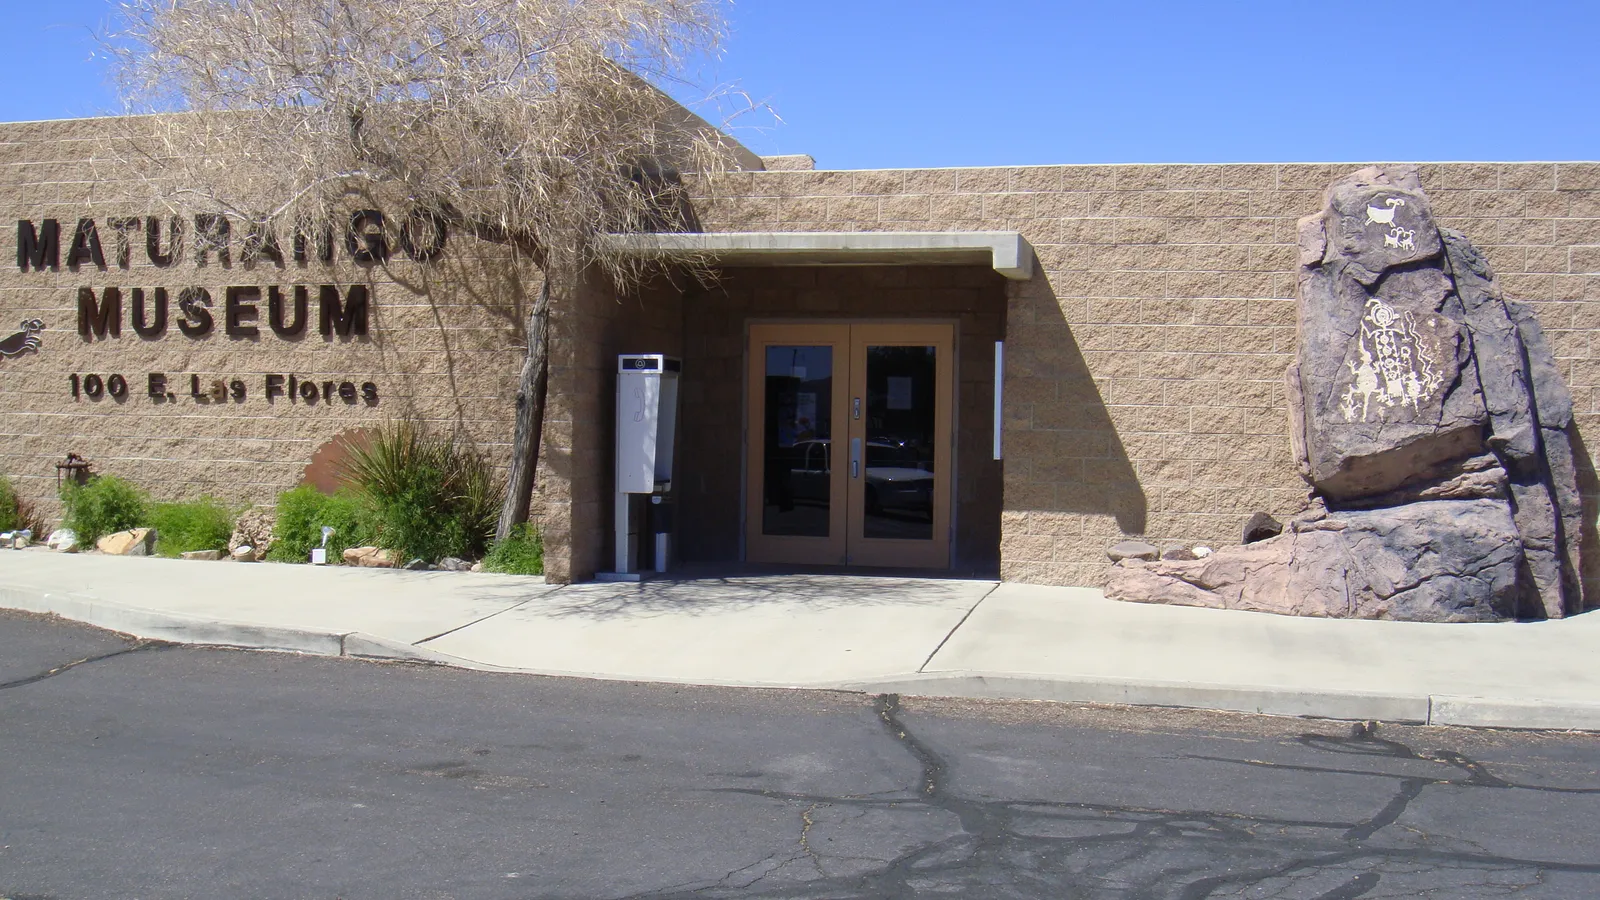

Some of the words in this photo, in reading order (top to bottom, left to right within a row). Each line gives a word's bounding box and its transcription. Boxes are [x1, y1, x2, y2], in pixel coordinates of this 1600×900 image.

[77, 285, 369, 338] MUSEUM
[69, 373, 127, 399] 100
[148, 373, 174, 400] E.
[190, 374, 246, 400] Las
[265, 374, 378, 405] Flores
